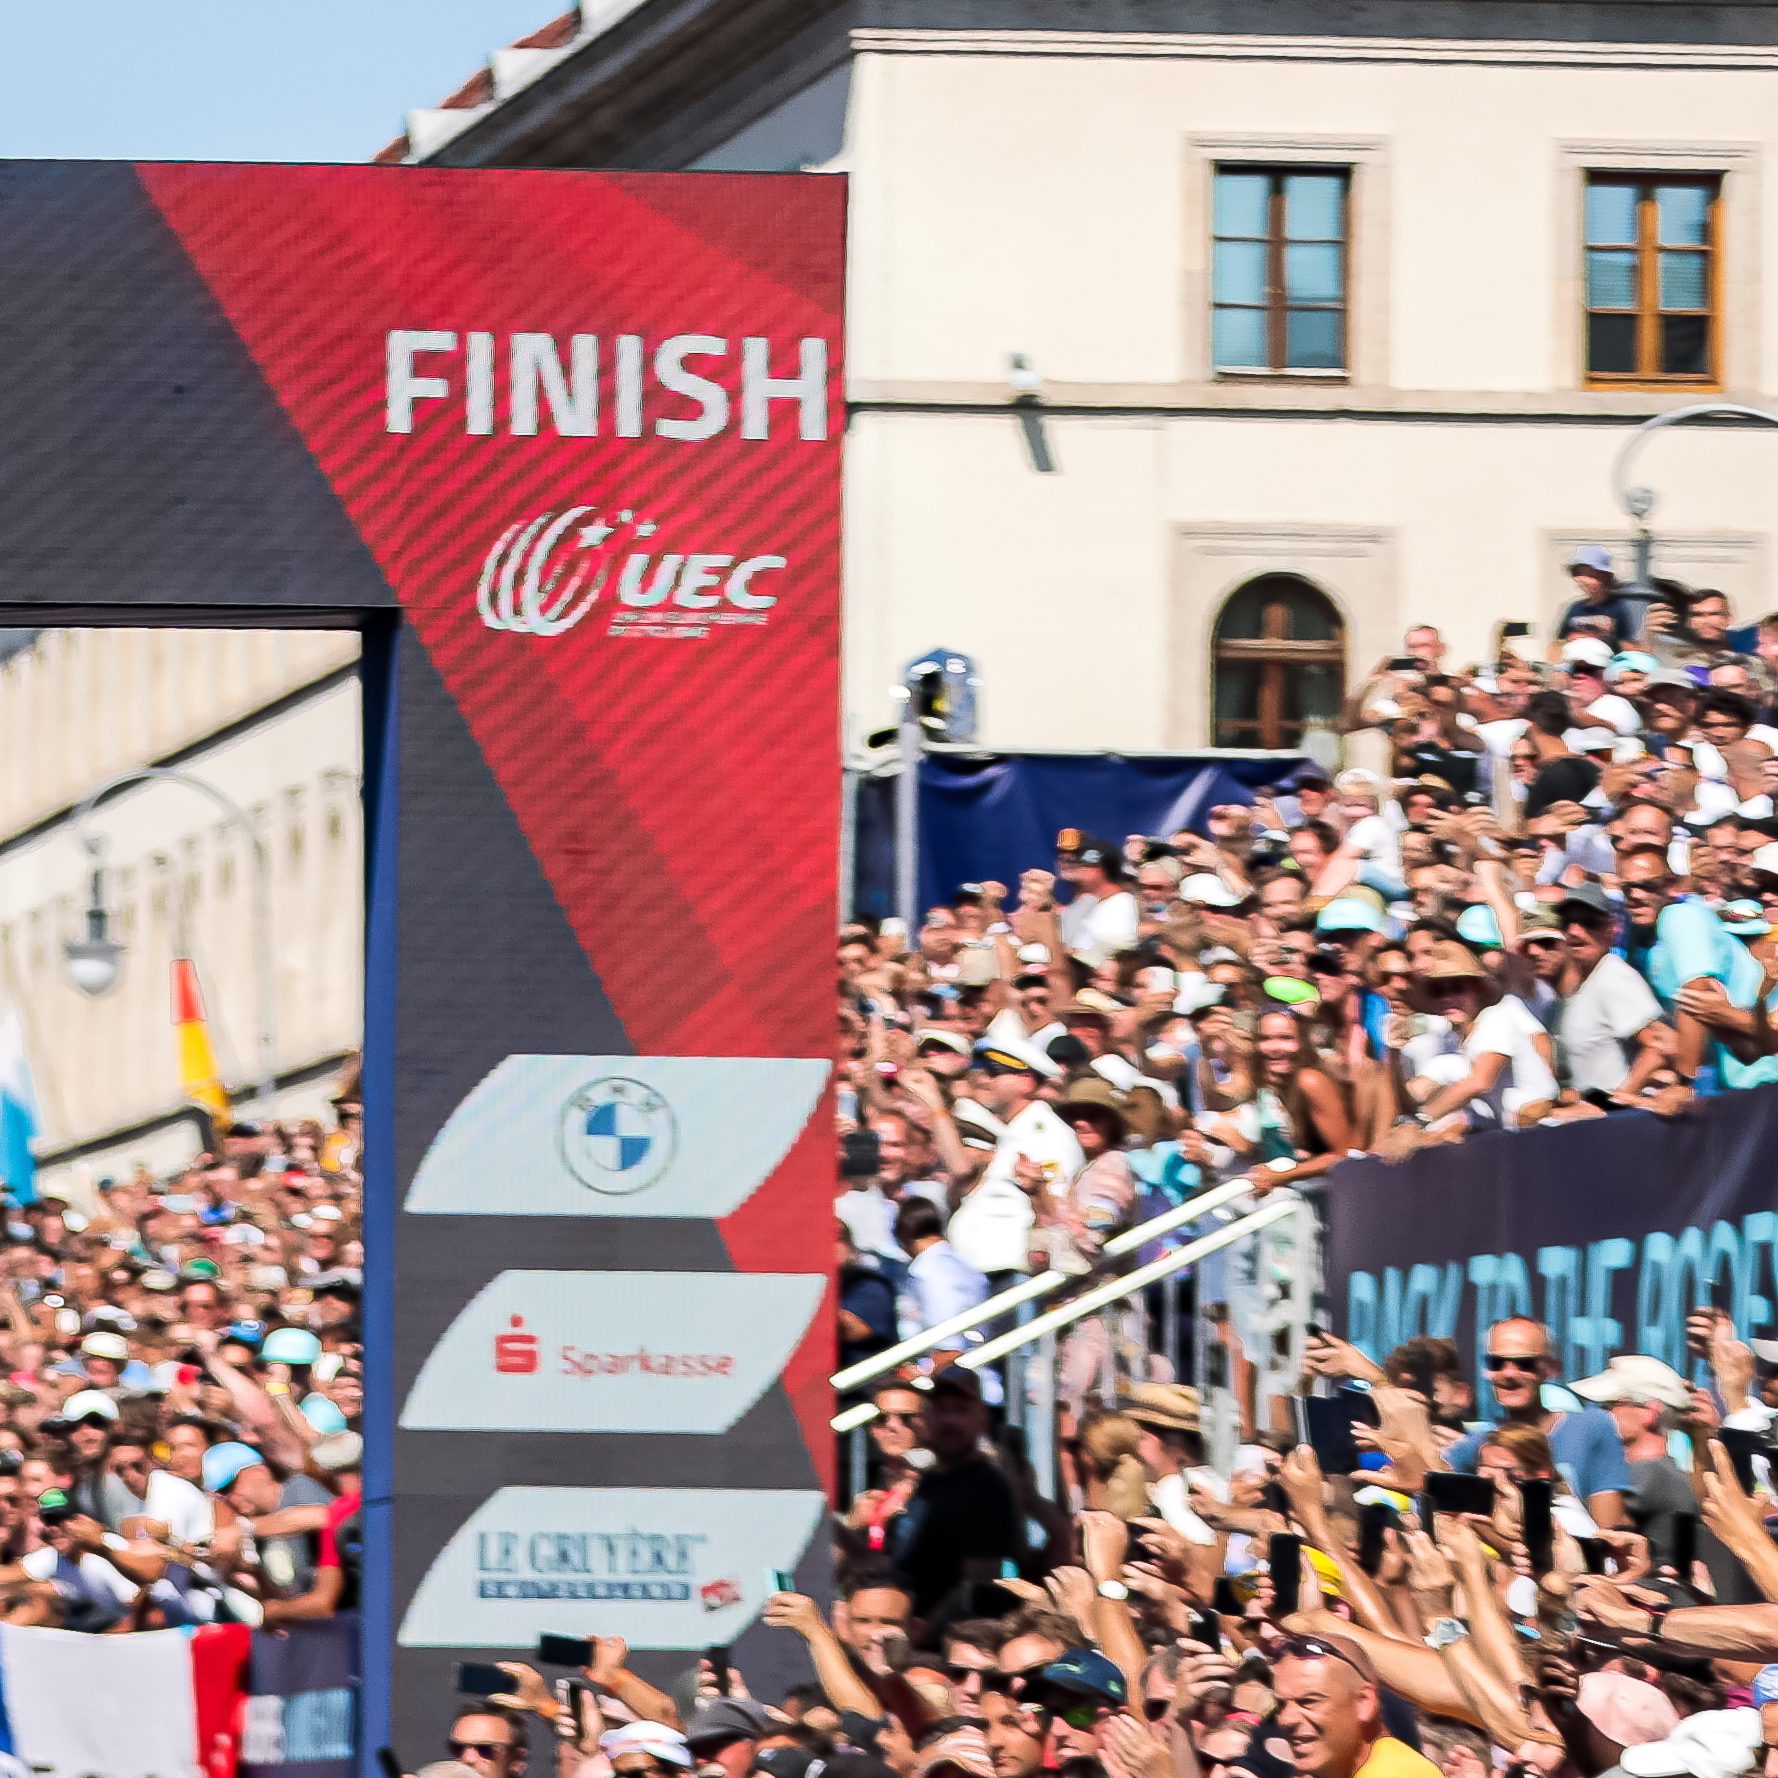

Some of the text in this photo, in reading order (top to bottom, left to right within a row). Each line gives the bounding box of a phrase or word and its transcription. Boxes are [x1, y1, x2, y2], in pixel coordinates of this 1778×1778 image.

[385, 329, 830, 443] FINISH
[618, 553, 788, 610] UEC
[559, 1345, 737, 1381] Sparkasse
